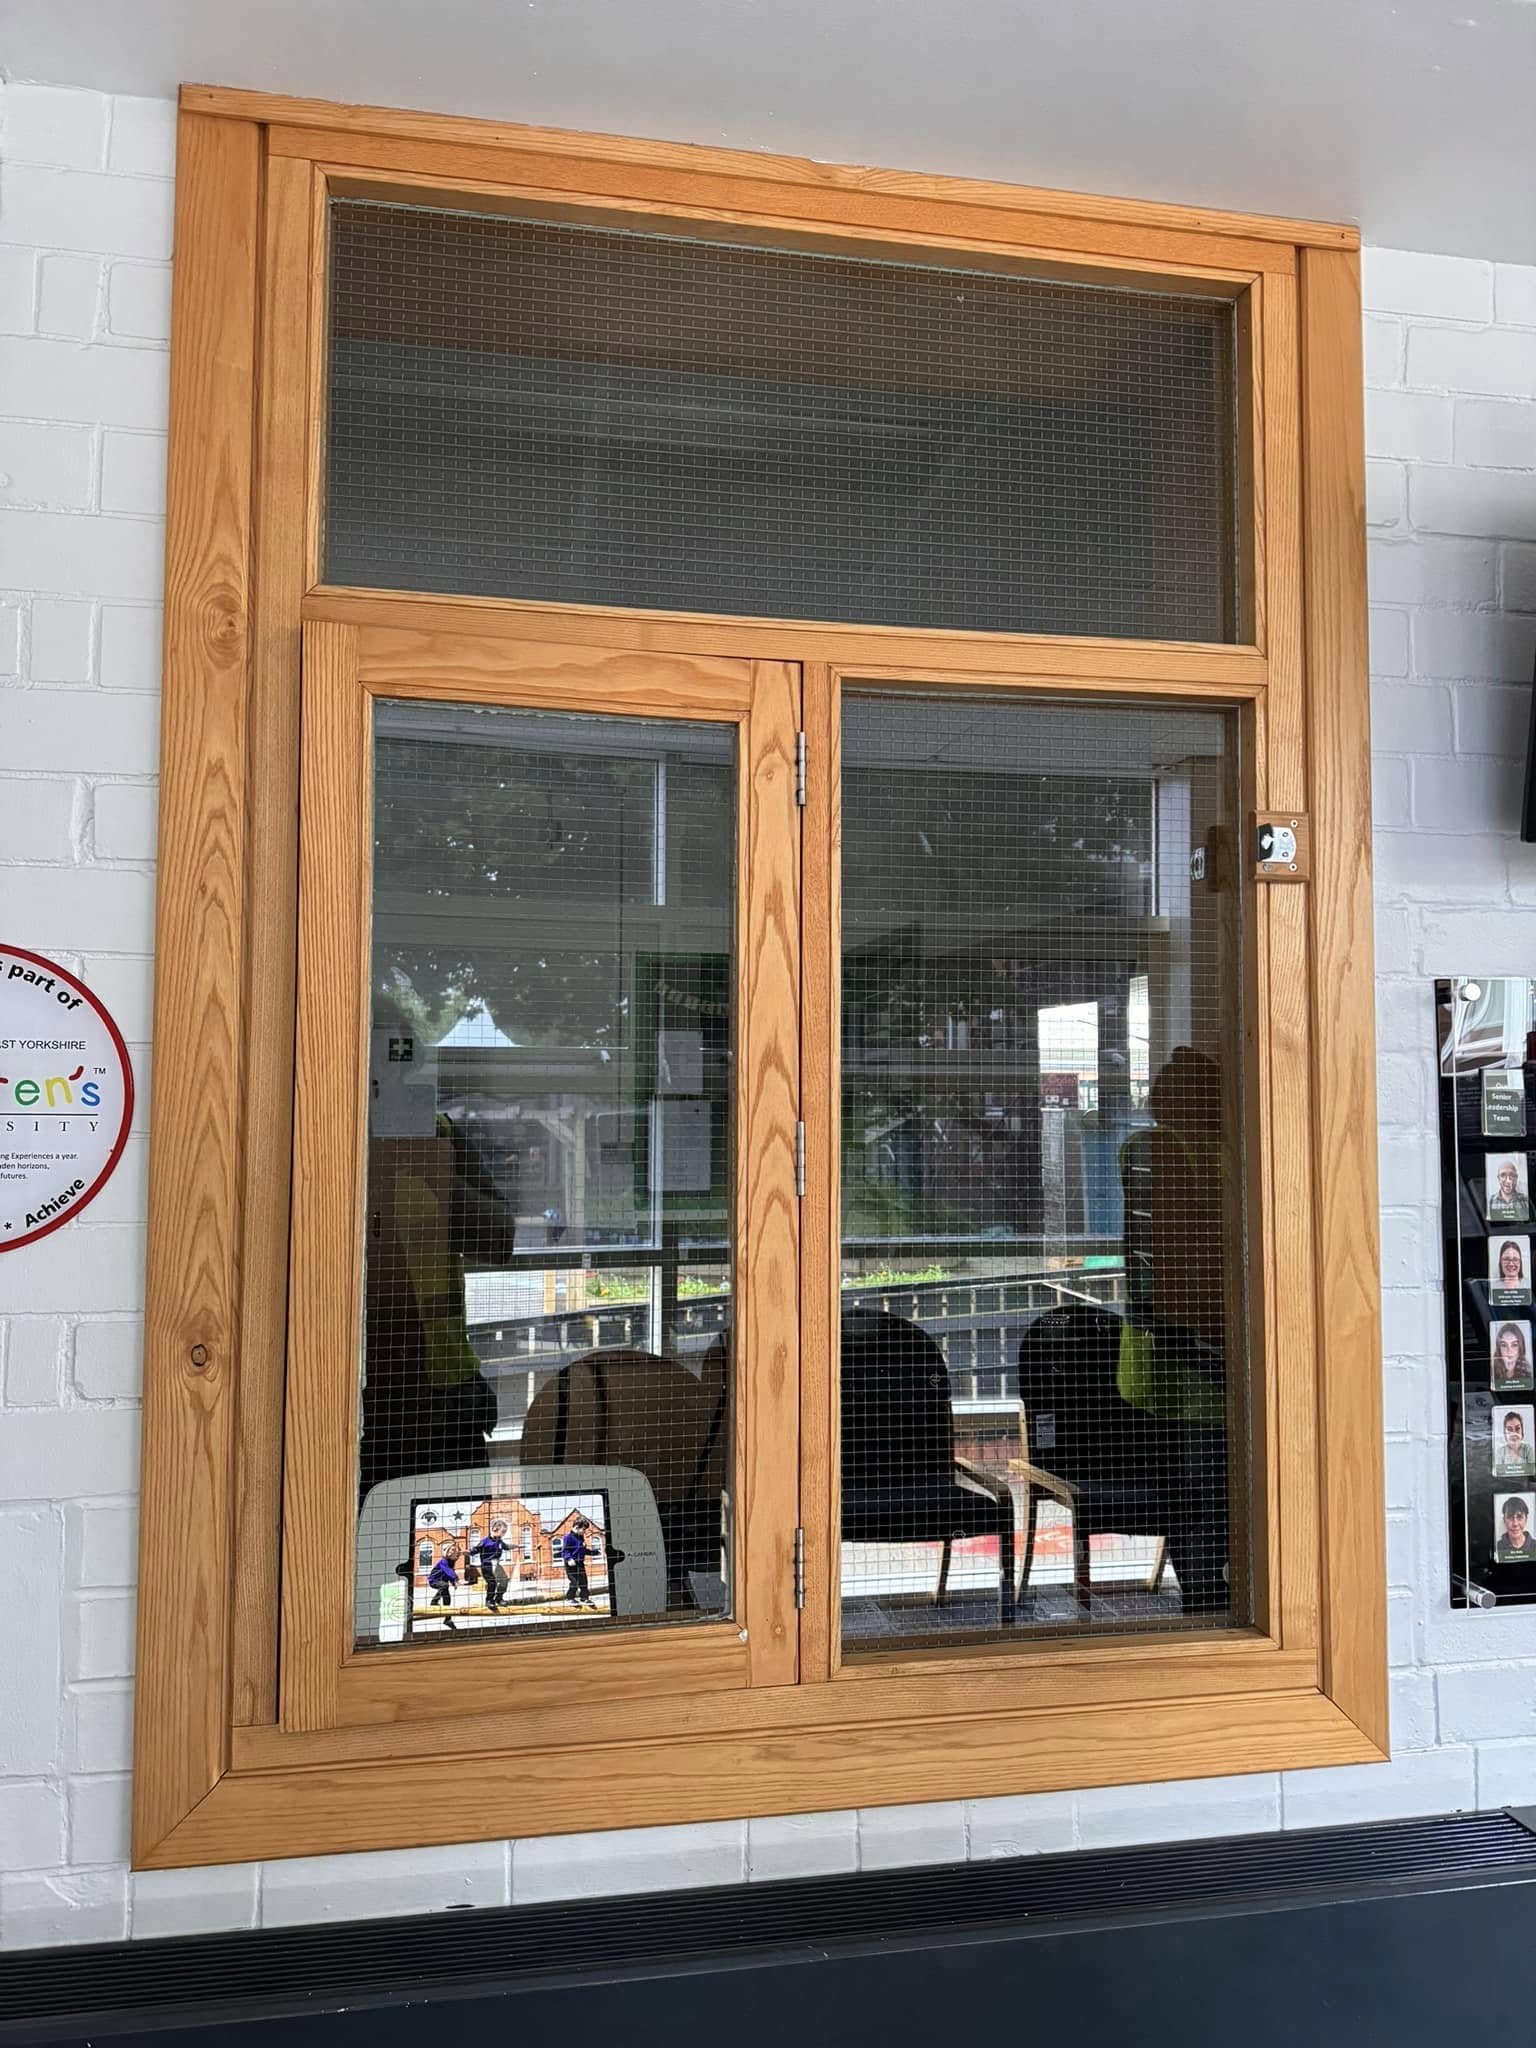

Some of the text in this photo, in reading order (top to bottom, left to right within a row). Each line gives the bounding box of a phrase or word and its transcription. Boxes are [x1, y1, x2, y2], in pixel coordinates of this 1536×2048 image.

[7, 964, 56, 993] part
[57, 991, 83, 1010] of
[0, 1040, 87, 1050] ST YORKSHIRE
[11, 1152, 54, 1160] Experiences
[17, 1162, 50, 1170] horizons,
[25, 1178, 85, 1228] Achieve
